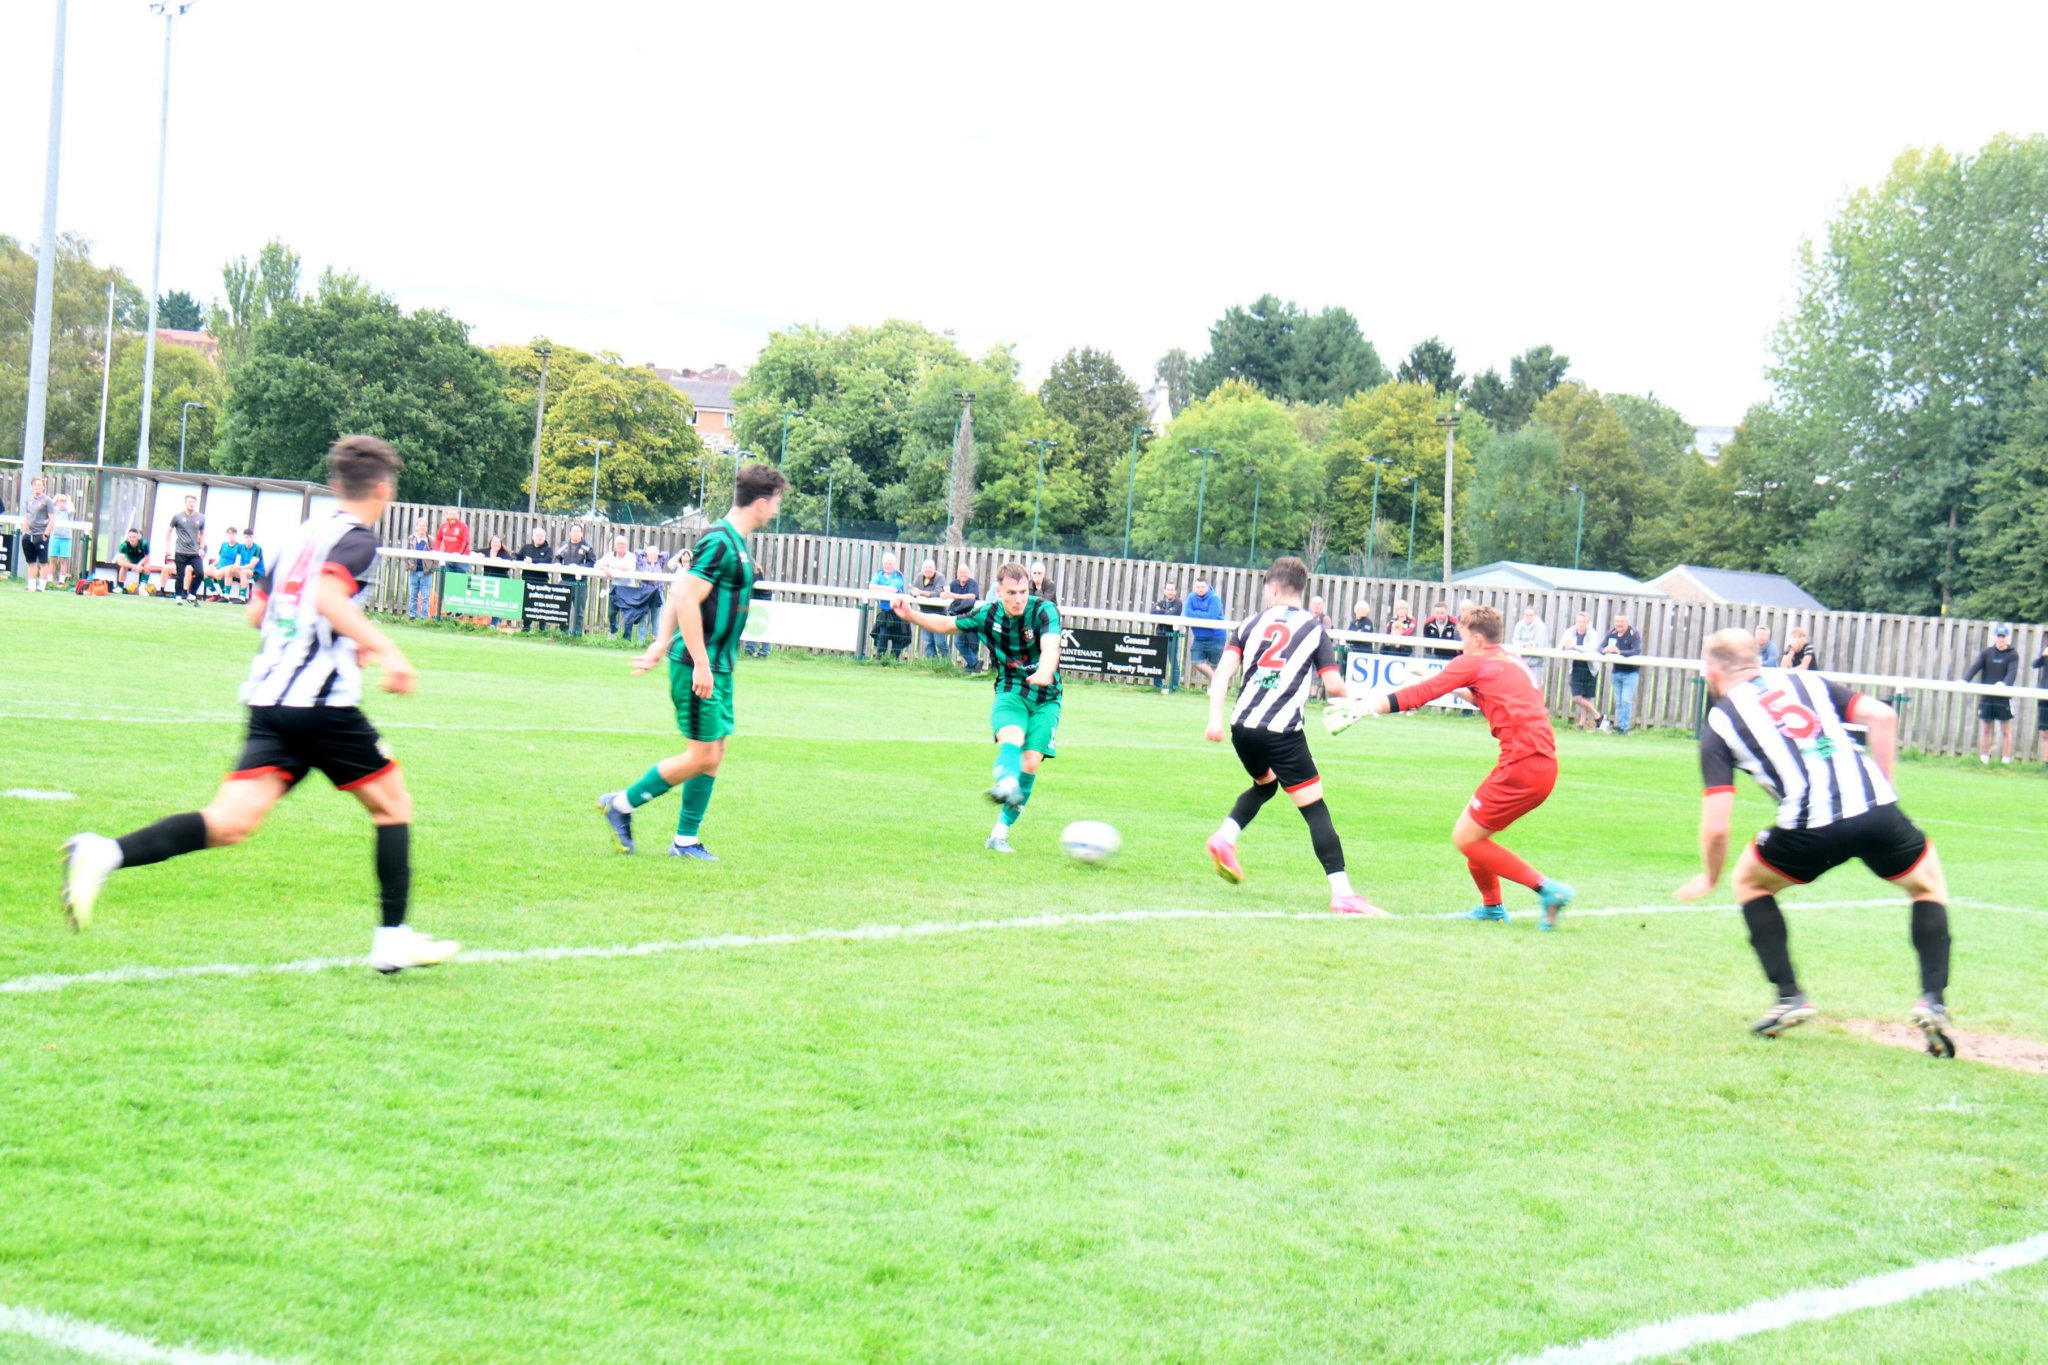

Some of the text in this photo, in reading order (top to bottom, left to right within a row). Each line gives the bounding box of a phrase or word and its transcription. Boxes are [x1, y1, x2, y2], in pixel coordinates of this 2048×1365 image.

[1123, 636, 1149, 645] General
[1257, 623, 1291, 669] 2
[1115, 644, 1157, 655] Maintenance
[1129, 655, 1142, 663] and
[1107, 662, 1162, 676] Property Repairs
[1351, 657, 1406, 689] SJC
[1758, 688, 1819, 739] 5
